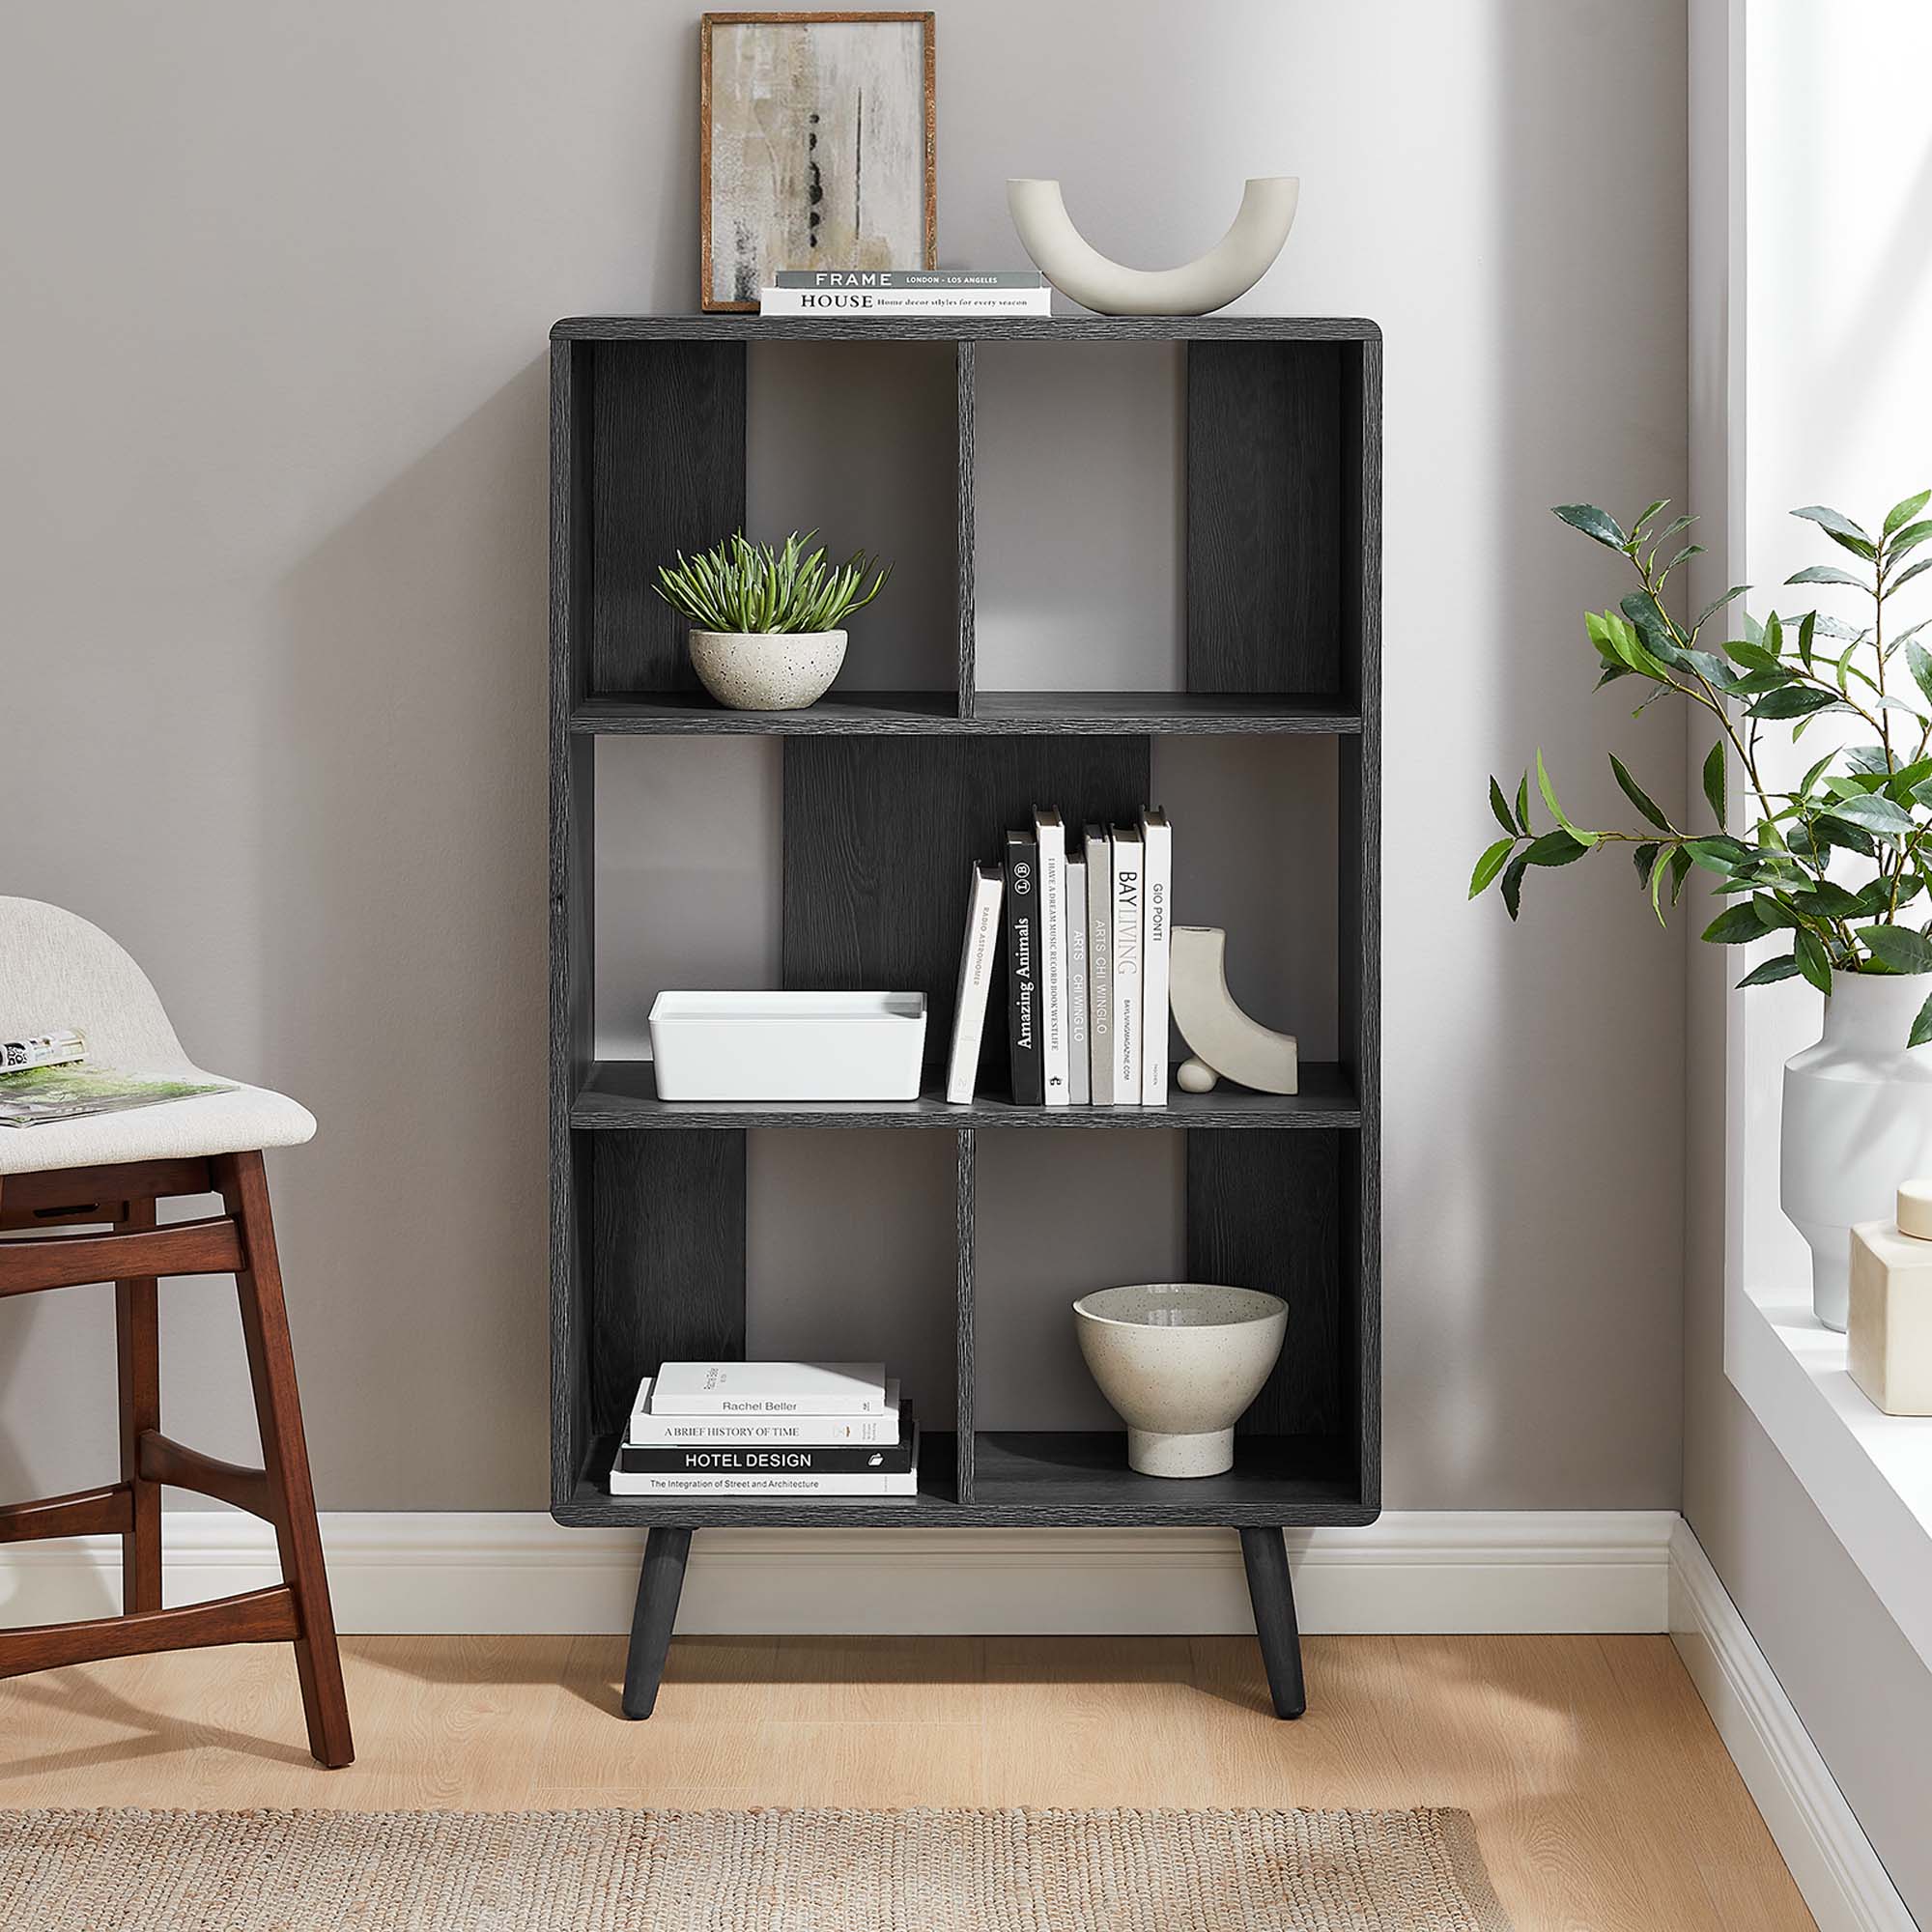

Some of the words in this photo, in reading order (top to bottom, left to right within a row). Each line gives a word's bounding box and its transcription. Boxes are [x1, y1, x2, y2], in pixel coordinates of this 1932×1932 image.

[816, 273, 892, 286] FRAME
[800, 294, 874, 308] HOUSE
[1048, 862, 1056, 885] HAVE
[1152, 883, 1164, 904] GIO
[980, 906, 990, 932] RADIO
[1049, 893, 1057, 923] DREAM
[1095, 920, 1106, 952] ARTS
[1152, 907, 1163, 942] PONTI
[1014, 918, 1030, 978] Animals
[1049, 924, 1057, 950] MUSIC
[1074, 930, 1083, 961] ARTS
[1050, 951, 1058, 984] RECORD
[1096, 957, 1107, 979] CHI
[1073, 974, 1083, 993] CHI
[1015, 981, 1034, 1049] Amazing
[1051, 1009, 1059, 1051] WESTLIFE
[722, 1401, 762, 1411] Rachel
[765, 1401, 797, 1411] Beller
[664, 1427, 672, 1436] A
[674, 1427, 705, 1436] BRIEF
[707, 1427, 754, 1436] HISTORY
[755, 1427, 772, 1436] OF
[773, 1427, 799, 1436] TIME
[685, 1454, 742, 1467] HOTEL
[747, 1454, 812, 1467] DESIGN
[650, 1480, 666, 1488] The
[668, 1480, 713, 1489] Integration
[714, 1480, 723, 1488] of
[724, 1480, 750, 1488] Street
[752, 1480, 767, 1488] and
[768, 1480, 819, 1488] Architecture
